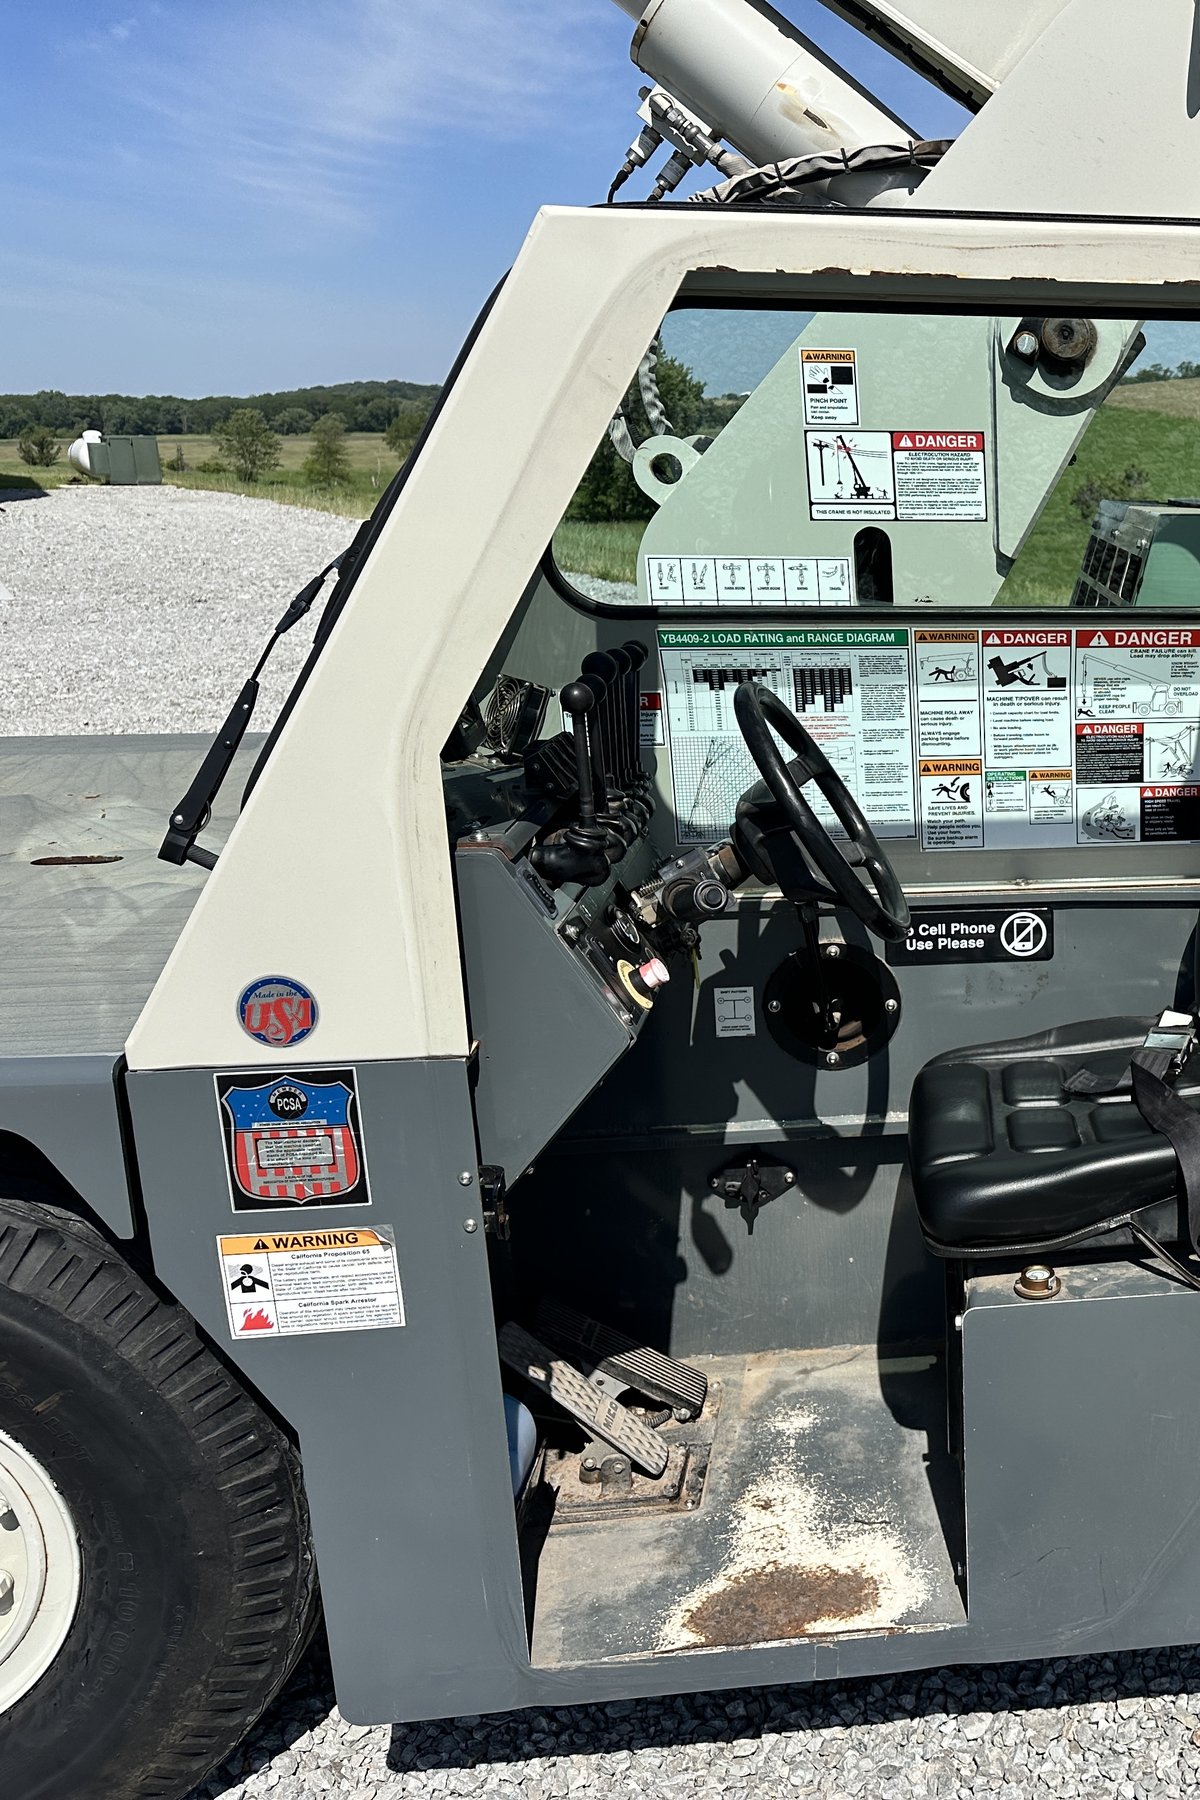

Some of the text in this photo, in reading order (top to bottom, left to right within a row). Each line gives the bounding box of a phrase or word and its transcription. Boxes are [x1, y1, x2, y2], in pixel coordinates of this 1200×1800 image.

[915, 435, 977, 447] DANGER
[661, 633, 895, 644] YB4409-2 LOAD RATING and RANGE DIAGRAM
[1004, 633, 1067, 644] DANGER
[1115, 631, 1192, 645] DANGER
[1094, 725, 1137, 733] DANGER
[932, 762, 980, 772] WARNING
[1155, 787, 1198, 797] DANGER
[918, 924, 945, 936] Cell
[950, 923, 996, 935] Phone
[906, 937, 984, 951] Use Please
[244, 997, 312, 1046] USA
[277, 1098, 302, 1111] PCSA
[272, 1232, 359, 1248] WARNING
[323, 1249, 360, 1258] Proposition
[602, 1401, 619, 1431] MICO
